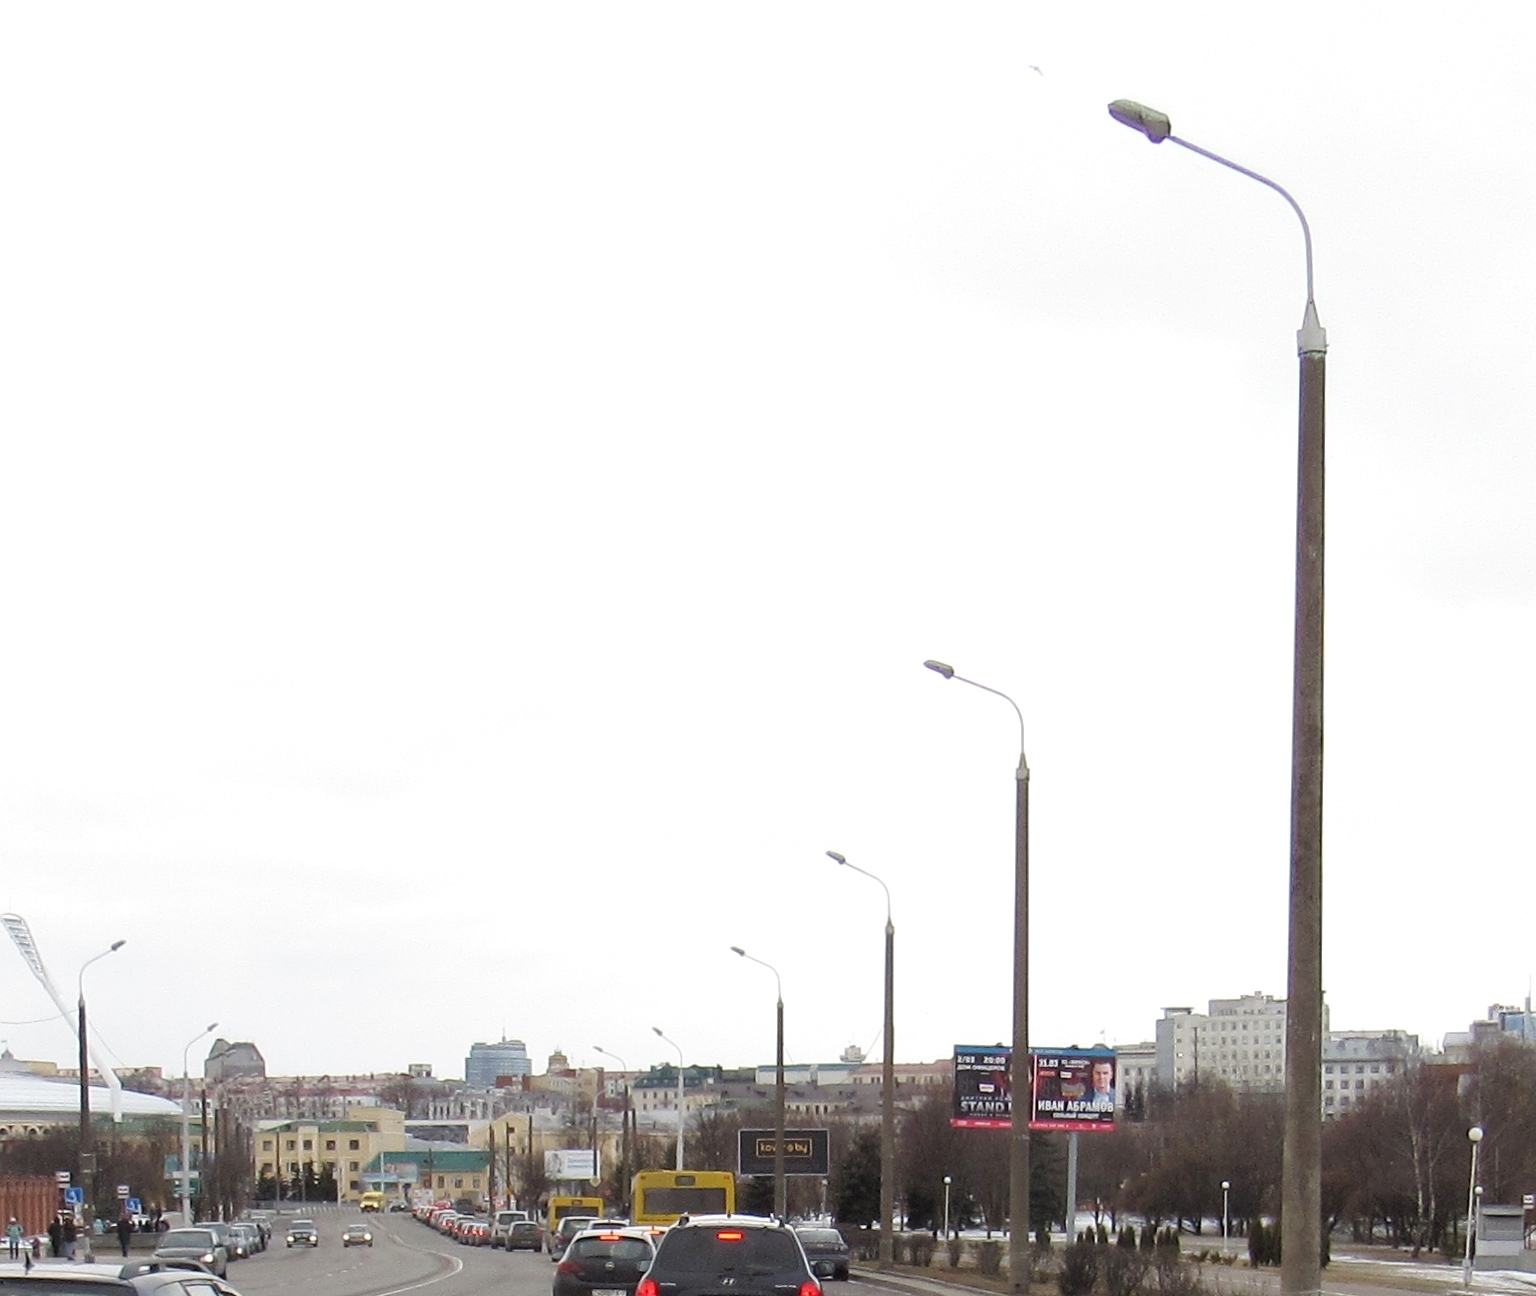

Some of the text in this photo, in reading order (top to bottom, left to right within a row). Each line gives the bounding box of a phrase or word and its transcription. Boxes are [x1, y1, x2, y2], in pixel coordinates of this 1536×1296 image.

[960, 1101, 1005, 1113] STAND
[1038, 1099, 1114, 1113] ИВАН АБРАМОВ
